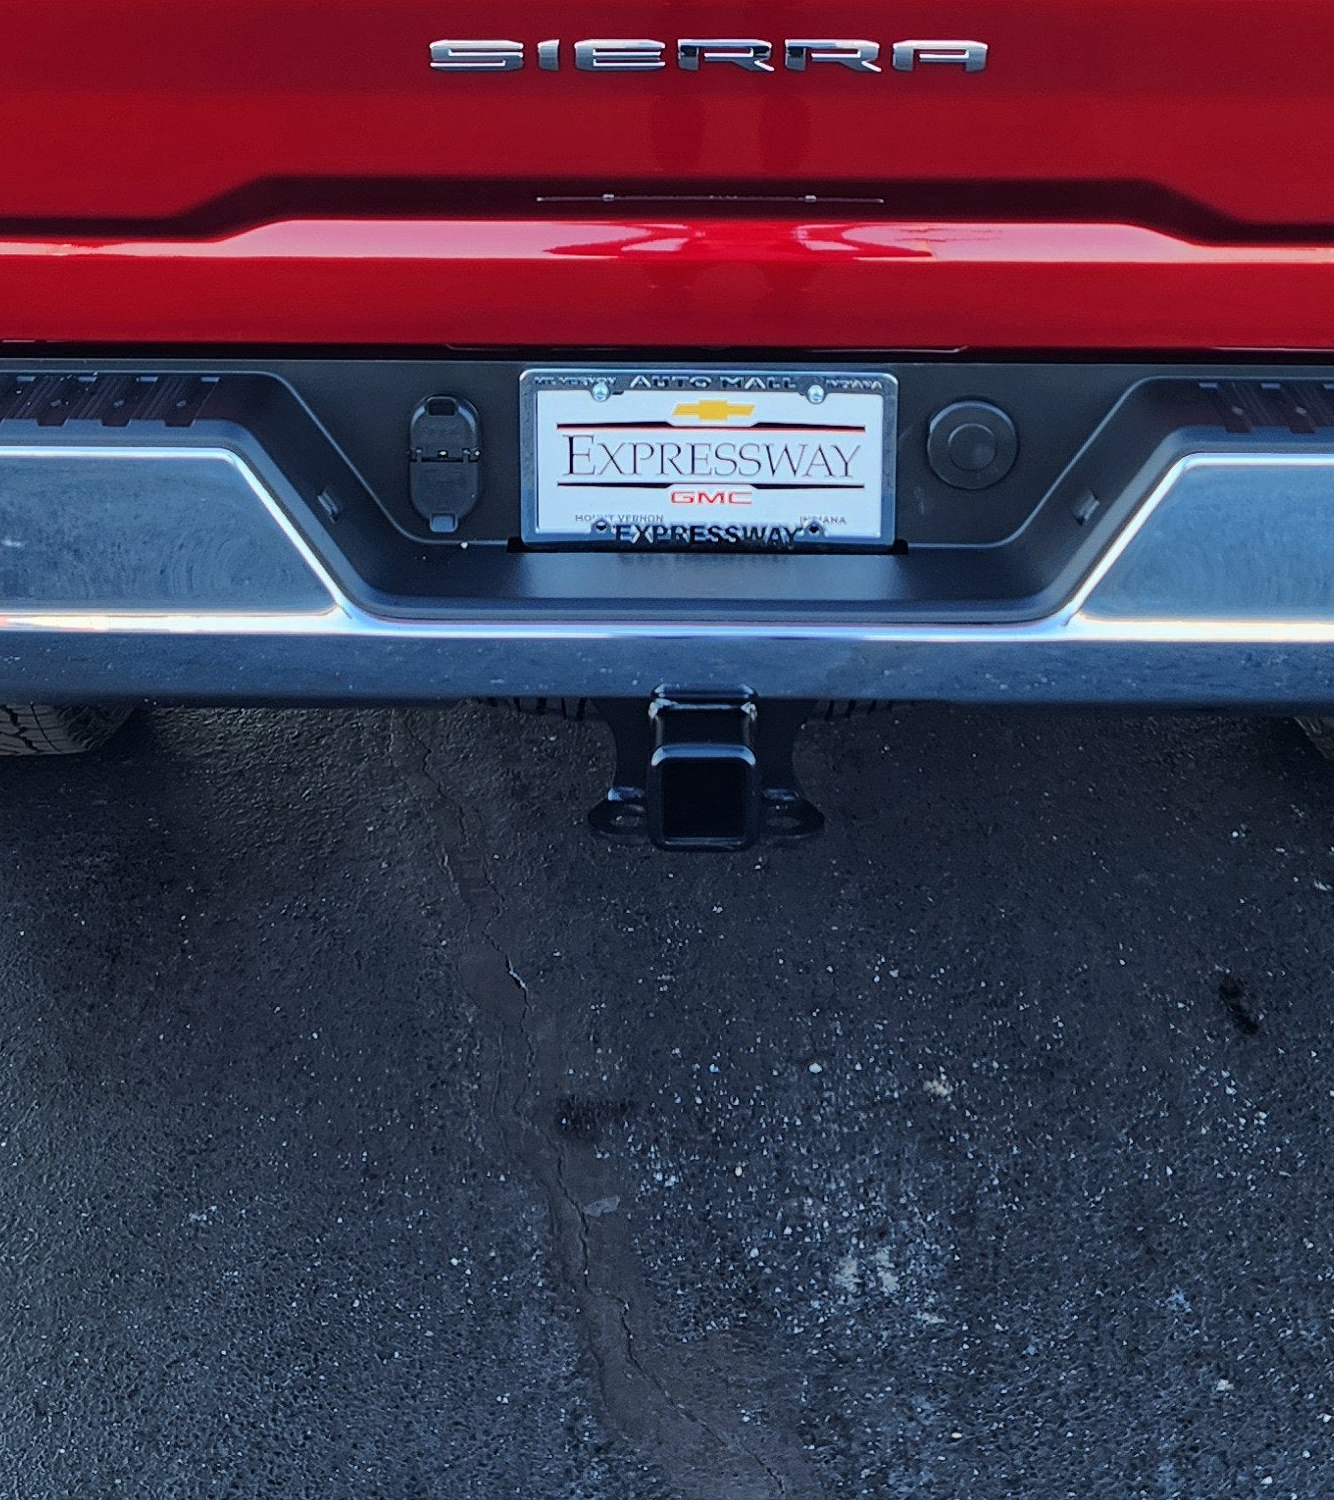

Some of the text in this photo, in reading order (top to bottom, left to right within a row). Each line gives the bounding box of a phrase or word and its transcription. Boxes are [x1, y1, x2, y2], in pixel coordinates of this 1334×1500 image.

[428, 38, 990, 72] SIERRA
[630, 375, 797, 390] AUTO MALL
[562, 434, 861, 478] EXPRESSWAY
[670, 490, 753, 505] GMC
[614, 523, 801, 546] EXPRESSWAY
